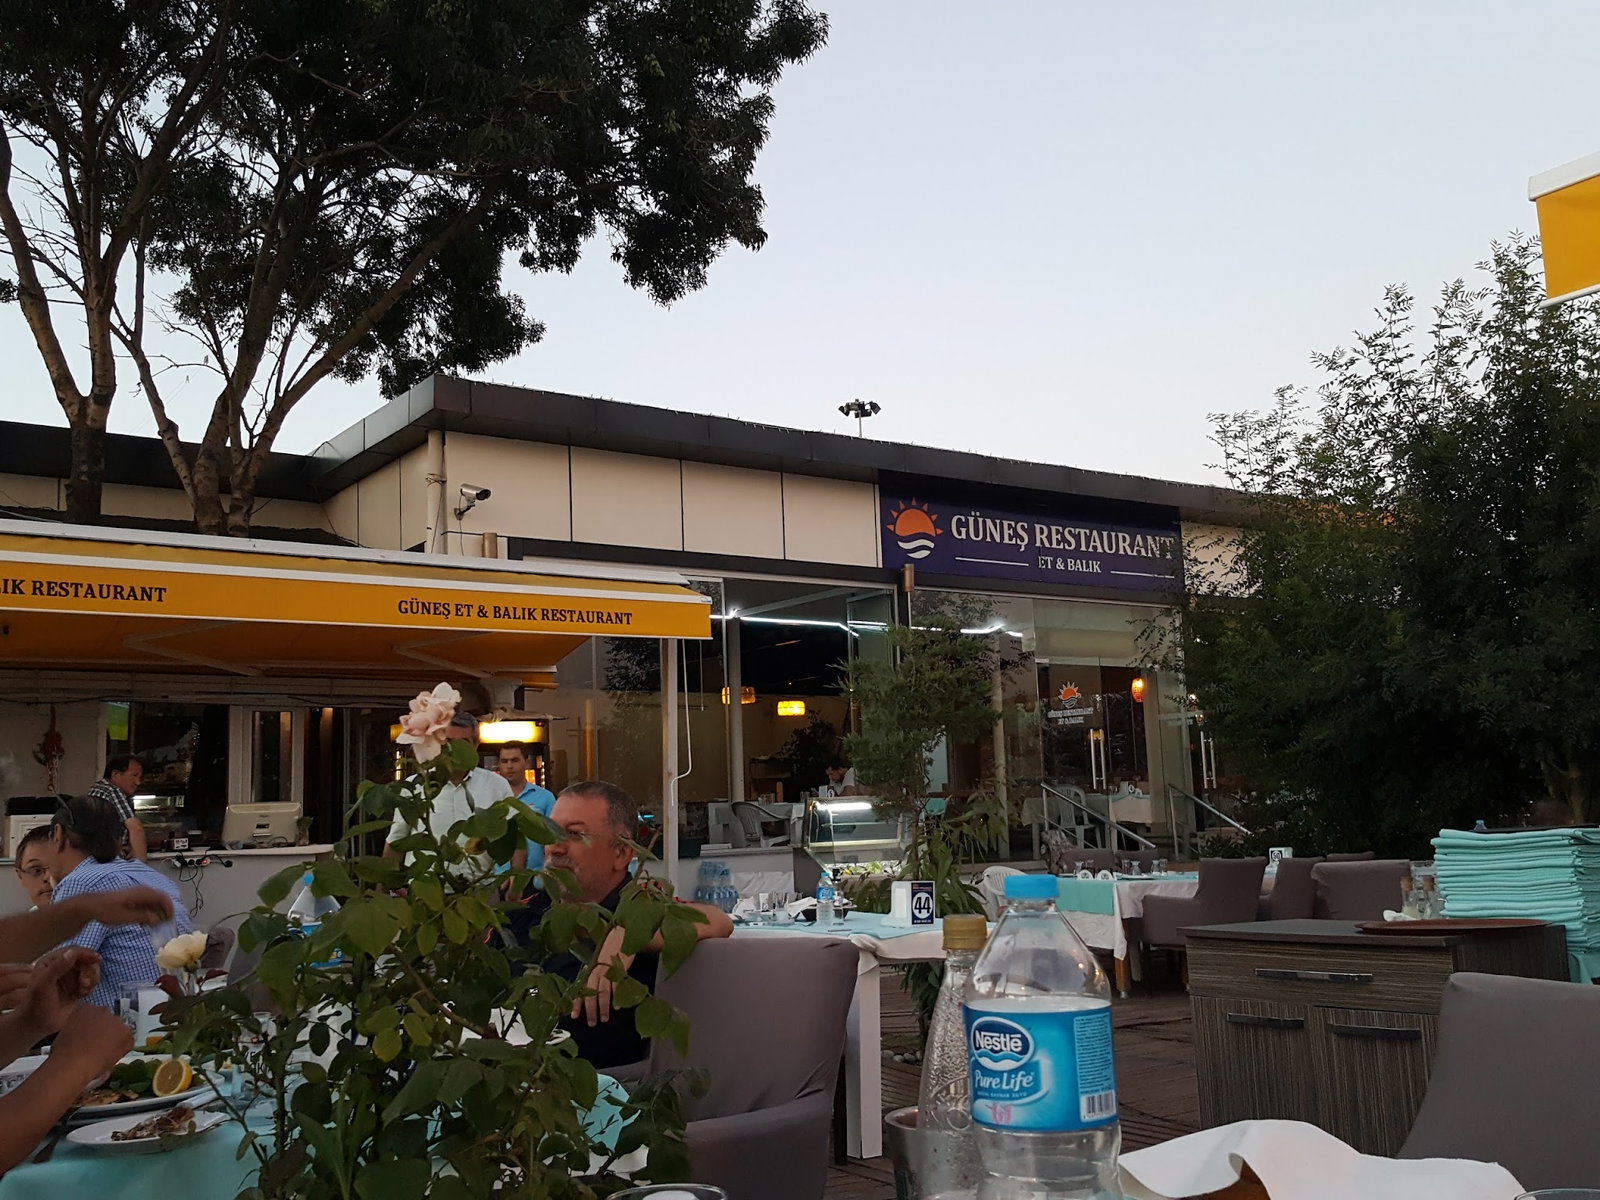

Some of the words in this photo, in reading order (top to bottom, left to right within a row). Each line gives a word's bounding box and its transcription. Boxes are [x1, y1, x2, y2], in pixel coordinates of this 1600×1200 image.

[951, 511, 1029, 552] GÜNEŞ
[1034, 523, 1174, 560] RESTAURANT
[1038, 556, 1053, 569] ET
[1056, 557, 1065, 570] &
[1067, 559, 1102, 573] BALIK
[0, 578, 26, 595] IK
[31, 580, 167, 602] RESTAURANT
[398, 598, 450, 619] GÜNEŞ
[454, 603, 473, 617] ET
[477, 604, 489, 618] &
[492, 605, 537, 621] BALIK
[541, 608, 633, 625] RESTAURANT
[914, 896, 931, 914] 44
[974, 1069, 1000, 1089] Pure
[1002, 1071, 1034, 1092] Life
